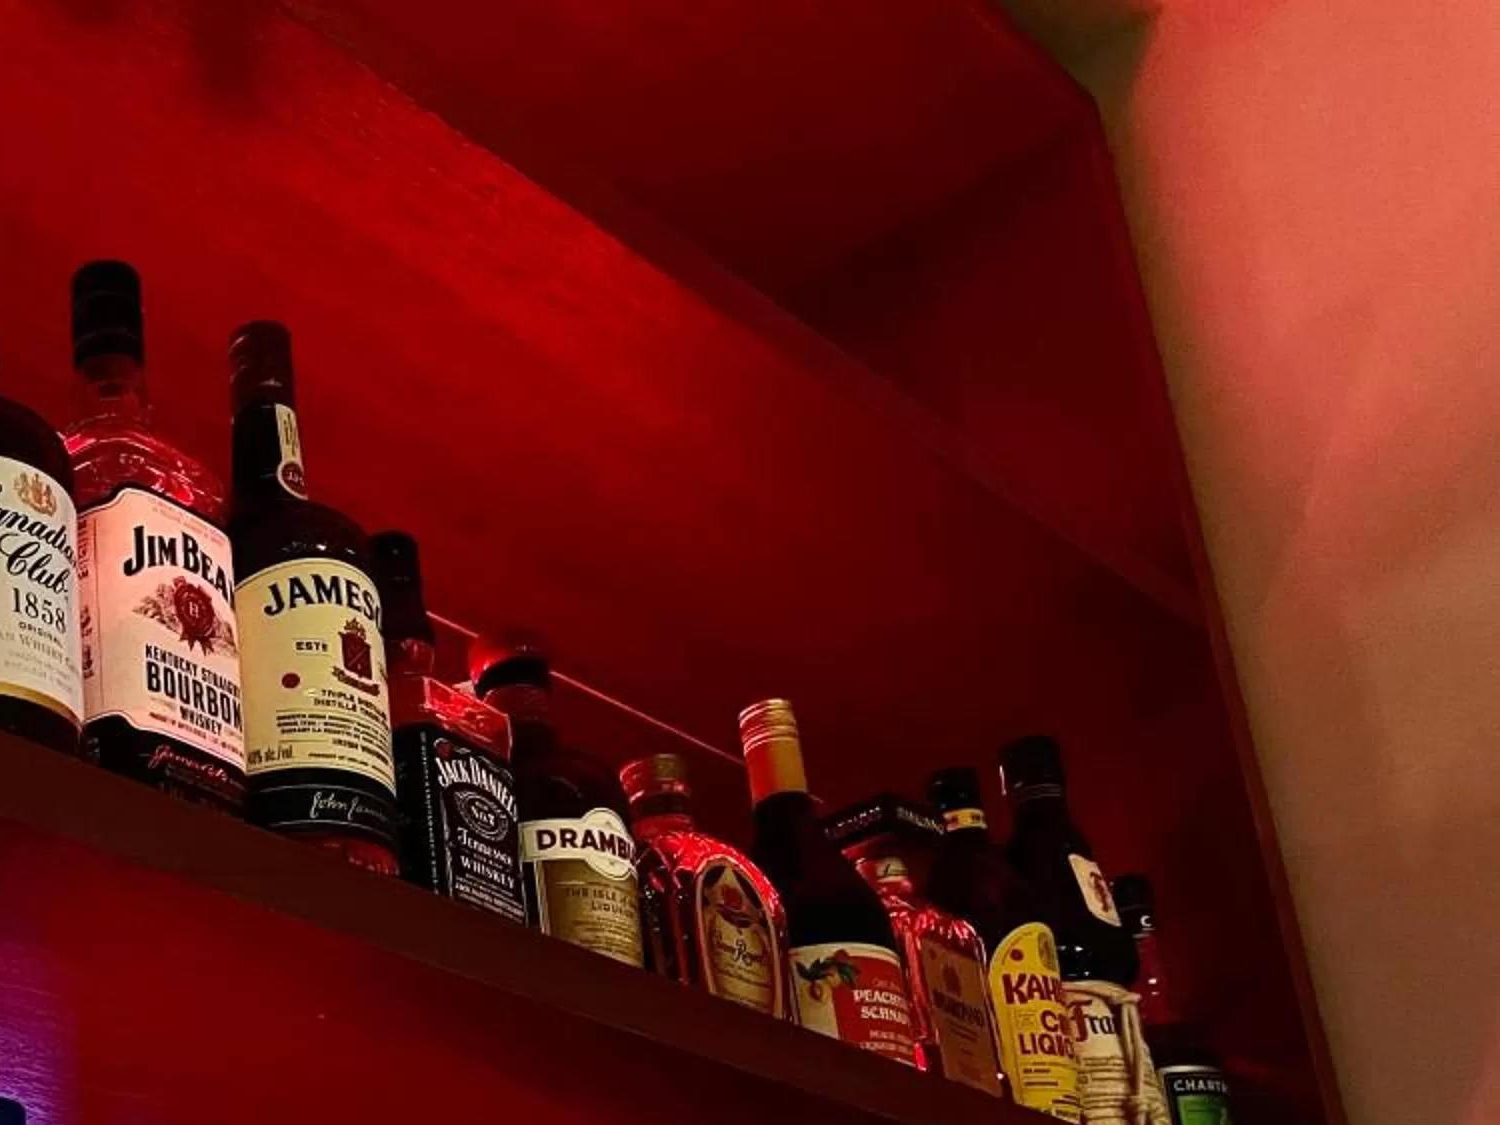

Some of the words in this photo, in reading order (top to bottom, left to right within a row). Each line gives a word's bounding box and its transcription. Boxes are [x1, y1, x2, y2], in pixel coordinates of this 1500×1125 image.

[123, 525, 178, 577] JIM
[12, 588, 67, 634] 1858
[146, 644, 198, 677] KENTUCKY
[147, 661, 243, 733] BOURBON
[180, 705, 223, 736] WHISKEY
[435, 756, 470, 787] JACK
[461, 855, 514, 890] WHISKEY
